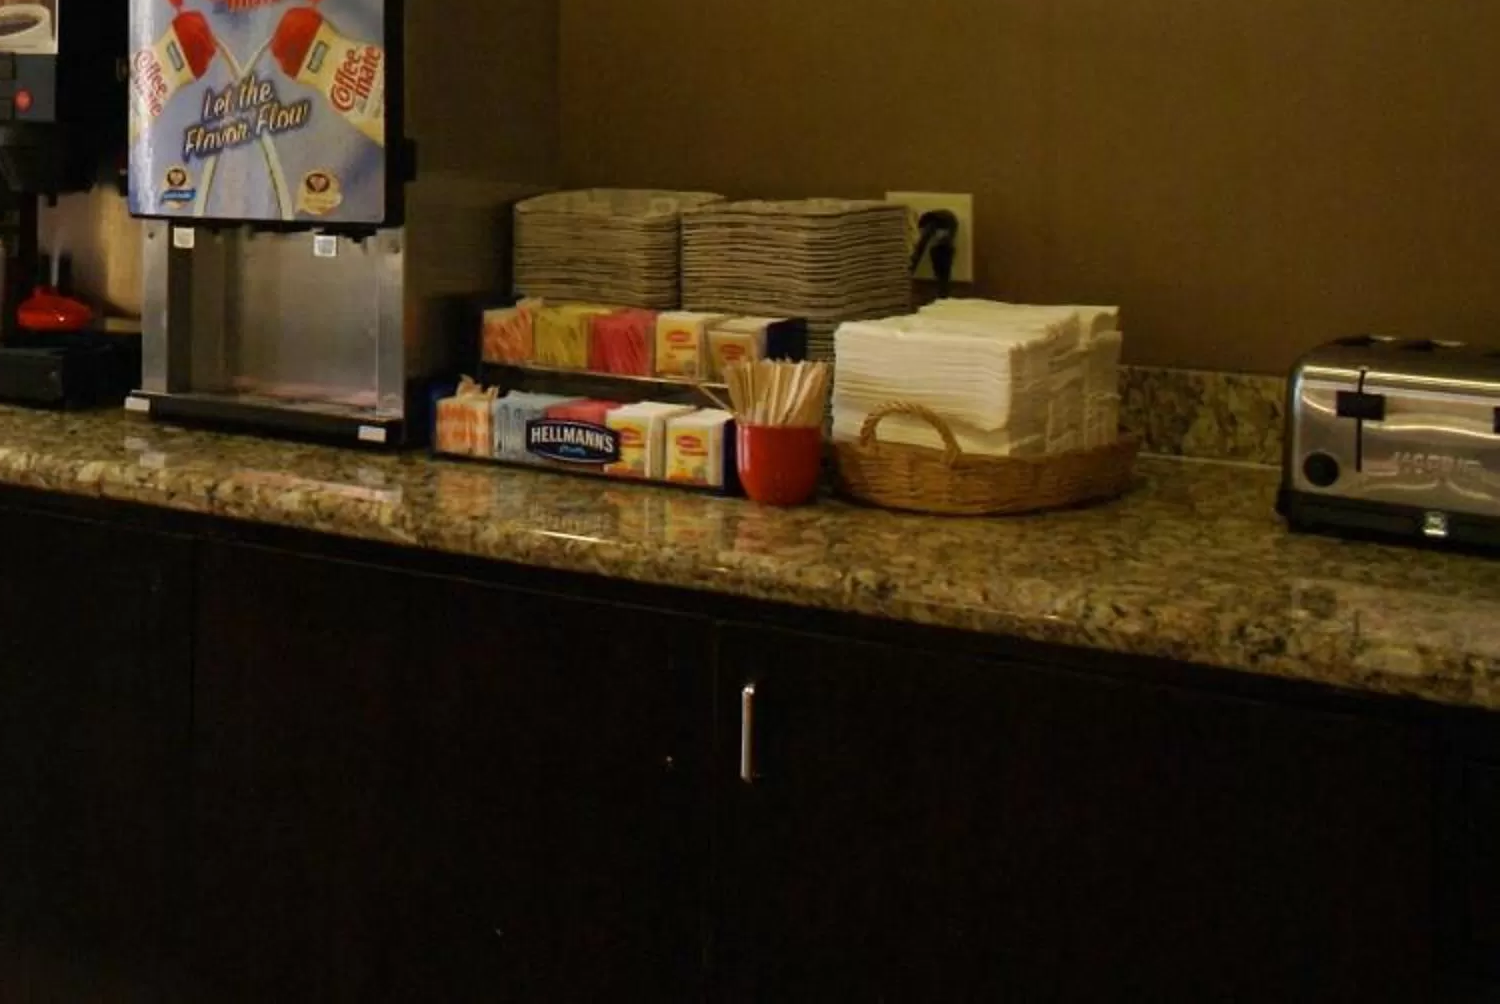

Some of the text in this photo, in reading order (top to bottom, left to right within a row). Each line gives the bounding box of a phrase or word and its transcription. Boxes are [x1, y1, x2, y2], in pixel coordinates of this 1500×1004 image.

[202, 76, 275, 118] Let the
[330, 48, 360, 112] Coffee
[184, 100, 310, 154] Flavor Flow
[530, 426, 614, 454] HELLMANN'S
